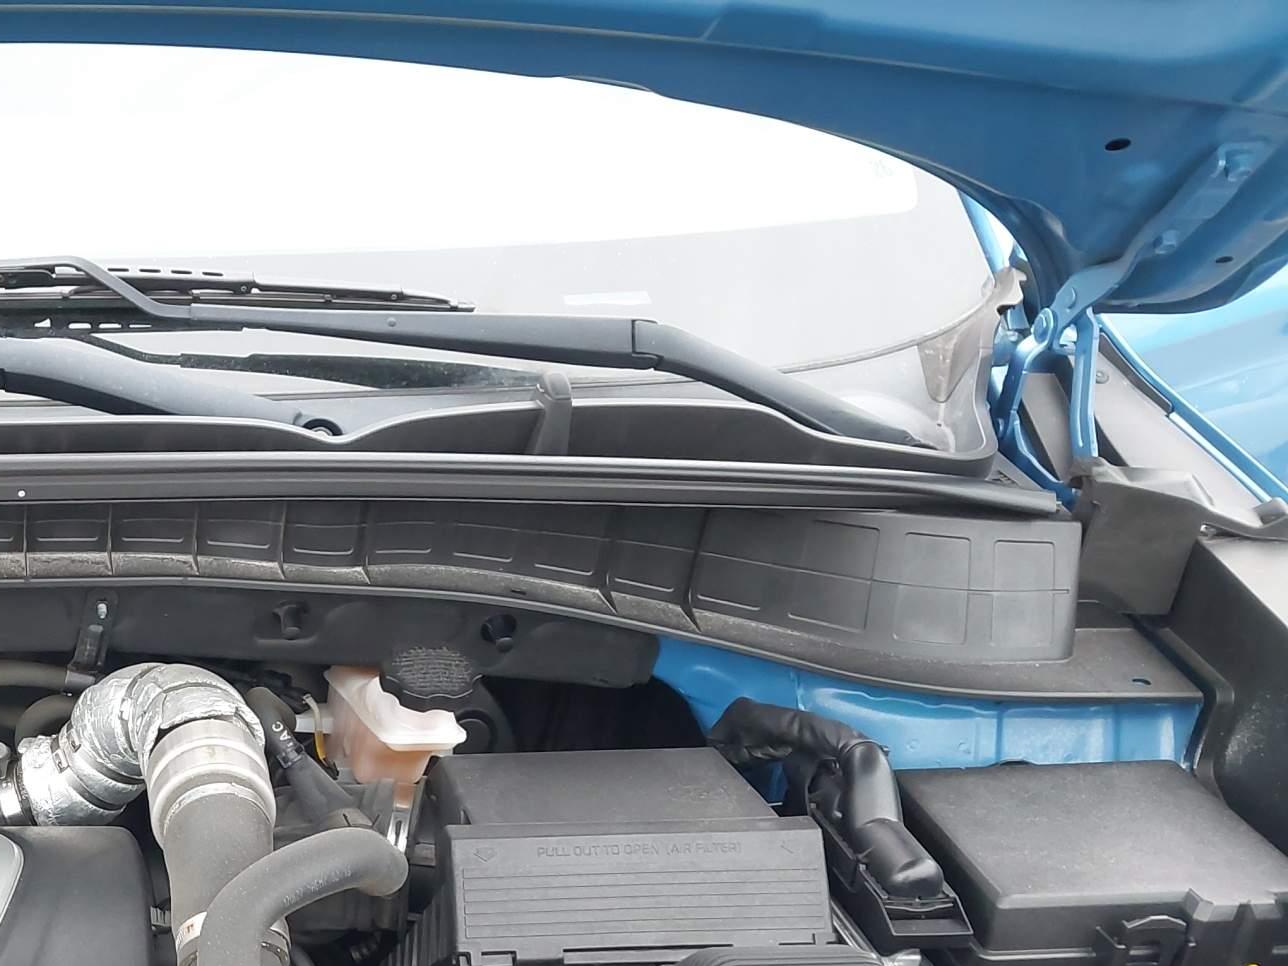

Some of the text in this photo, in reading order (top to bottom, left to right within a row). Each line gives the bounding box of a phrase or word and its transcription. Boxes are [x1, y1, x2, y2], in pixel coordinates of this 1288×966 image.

[537, 846, 570, 857] PULL
[574, 845, 600, 856] OUT
[604, 844, 620, 856] TO
[625, 843, 659, 856] OPEN
